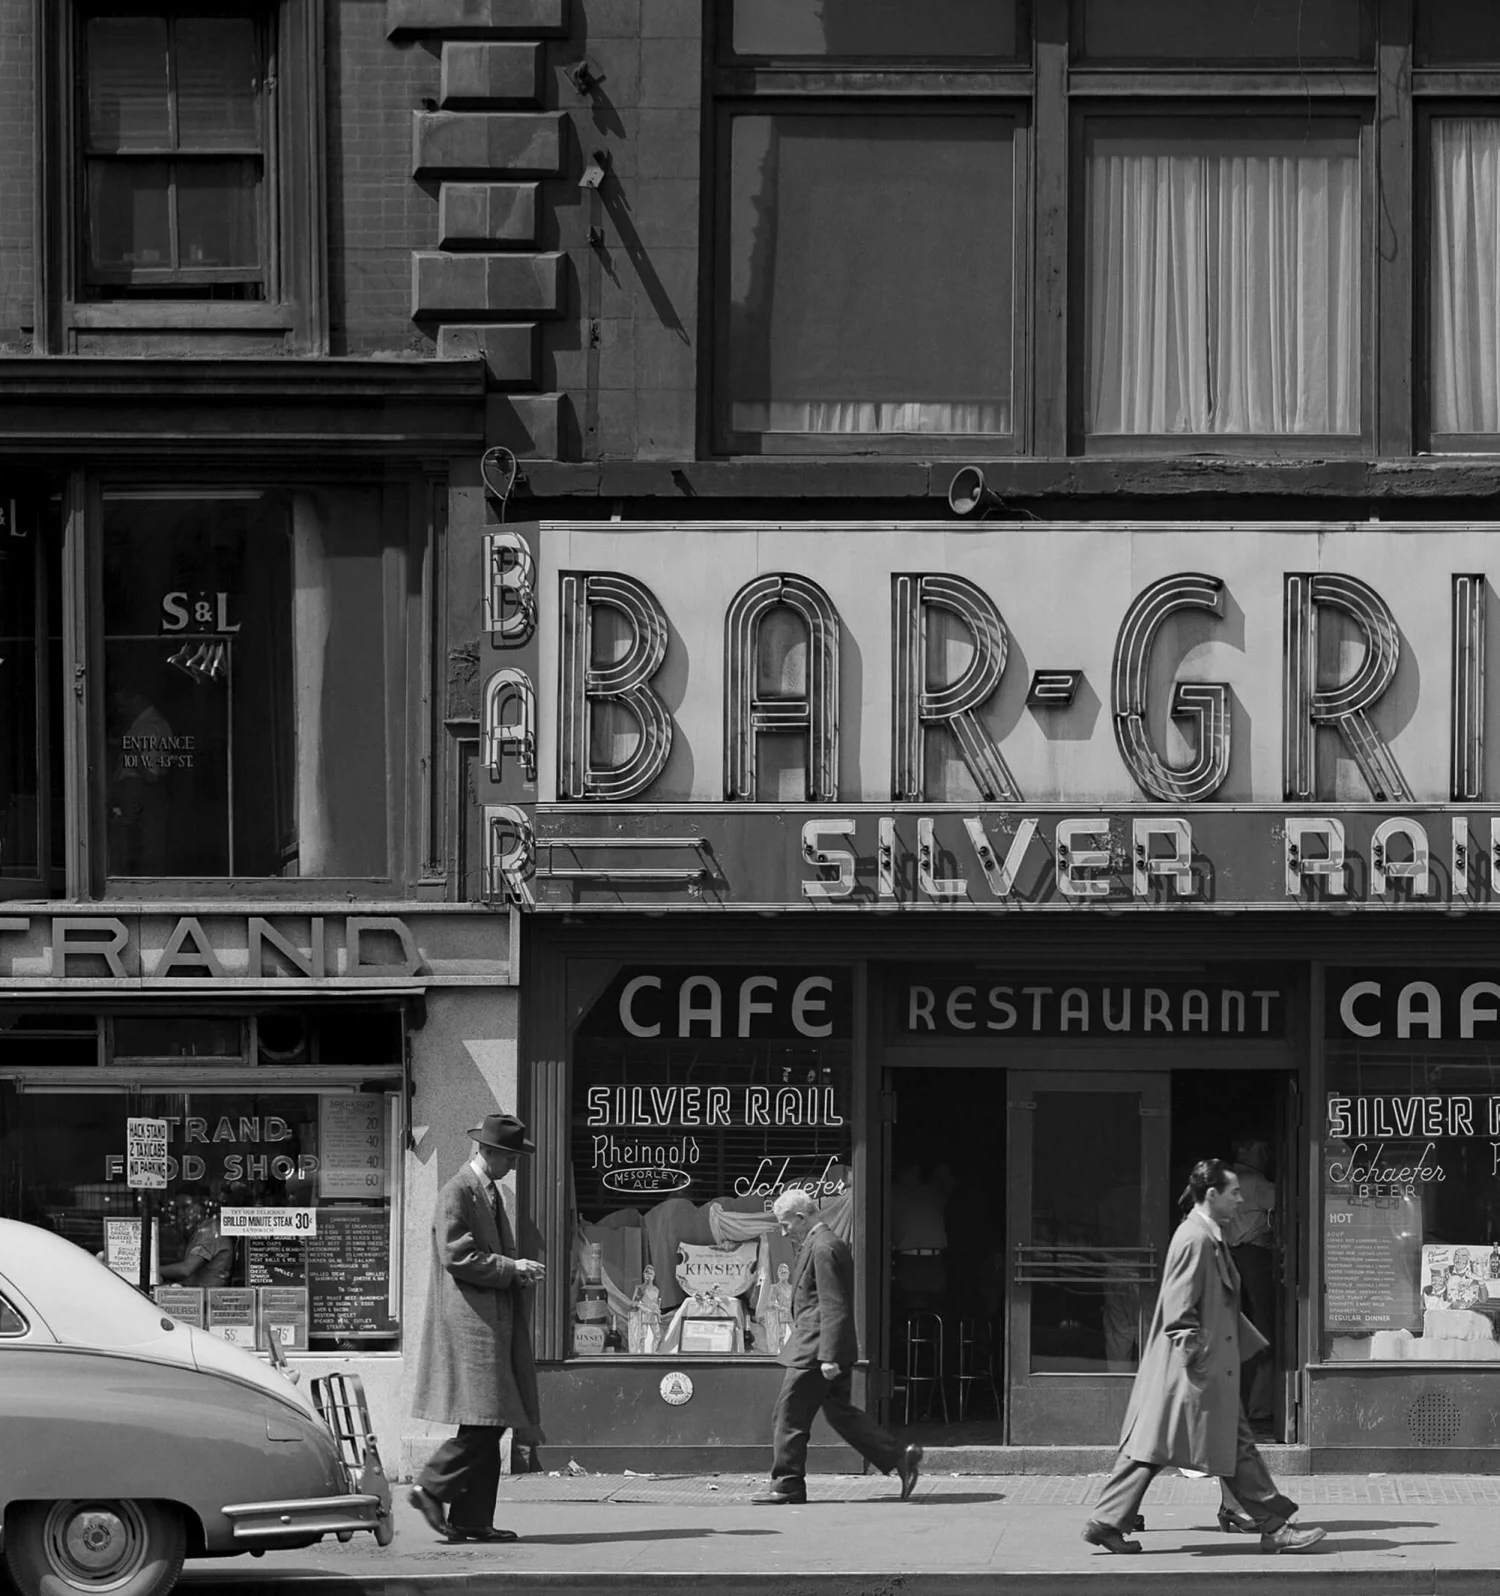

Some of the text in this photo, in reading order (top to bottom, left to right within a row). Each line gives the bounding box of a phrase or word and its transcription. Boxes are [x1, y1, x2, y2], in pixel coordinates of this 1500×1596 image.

[161, 591, 241, 633] S&L
[481, 532, 536, 905] BAR
[122, 735, 195, 750] ENTRANCE
[124, 754, 138, 767] 101
[801, 817, 1500, 897] SILVER RAI
[619, 975, 834, 1039] CAFE
[908, 985, 1280, 1031] RESTAURANT
[588, 1086, 843, 1126] SILVER RAIL
[366, 1117, 377, 1130] 20
[1328, 1096, 1474, 1138] SILVER
[129, 1123, 165, 1139] HACK STAND
[159, 1116, 292, 1143] TRAND
[130, 1142, 135, 1157] 2
[366, 1135, 378, 1148] 40
[592, 1134, 700, 1168] Rheingold
[129, 1160, 165, 1179] NO PARKING
[224, 1154, 320, 1180] SHOP
[366, 1155, 378, 1168] 40
[1329, 1143, 1445, 1184] Schaefer
[366, 1173, 378, 1186] 60
[633, 1180, 659, 1189] ALE
[1358, 1184, 1417, 1199] BEER
[223, 1216, 247, 1227] GRILLED
[248, 1216, 272, 1227] MINUTE
[273, 1216, 293, 1227] STEAK
[1329, 1213, 1353, 1223] HOT
[665, 1372, 688, 1381] PUBLIC
